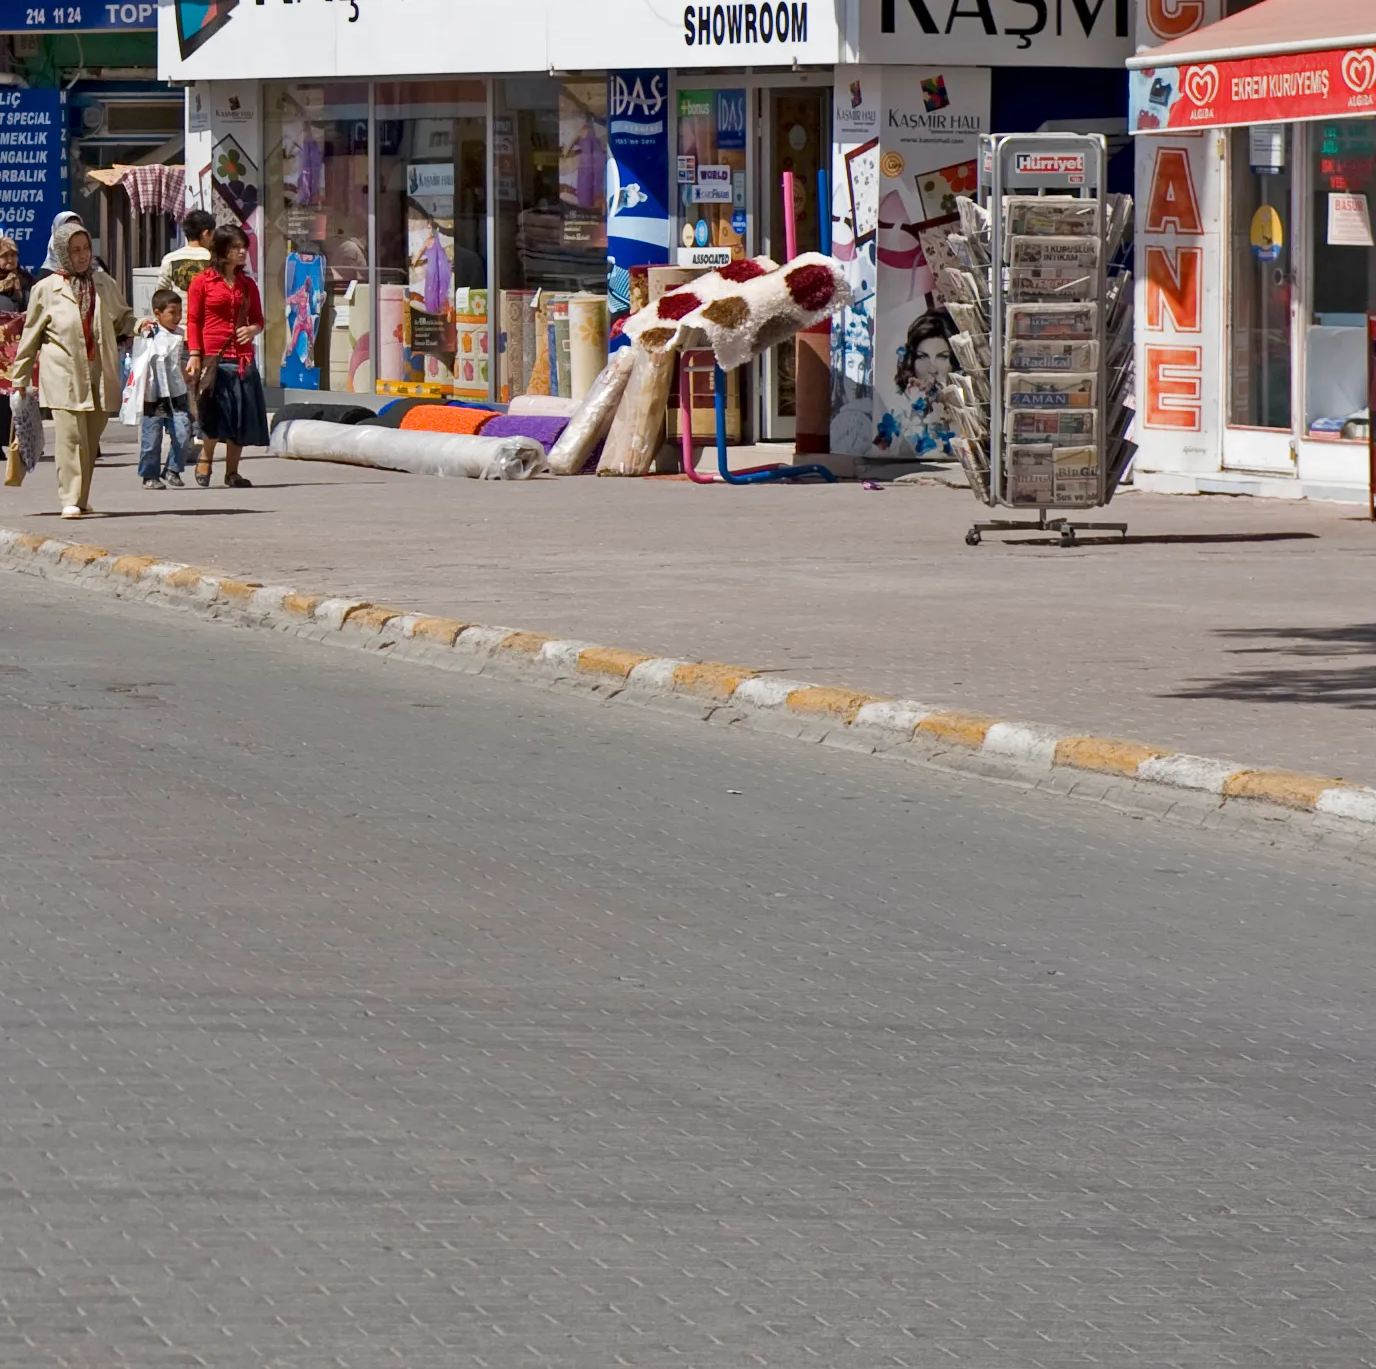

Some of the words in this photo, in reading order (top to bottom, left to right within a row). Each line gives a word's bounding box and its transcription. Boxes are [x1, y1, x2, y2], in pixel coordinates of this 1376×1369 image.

[26, 9, 45, 24] 214
[67, 8, 81, 23] 24
[683, 2, 808, 47] SHOWROOM
[1019, 155, 1084, 171] Hürriyet
[1022, 355, 1071, 369] Radikal
[1012, 393, 1067, 404] ZAMAN
